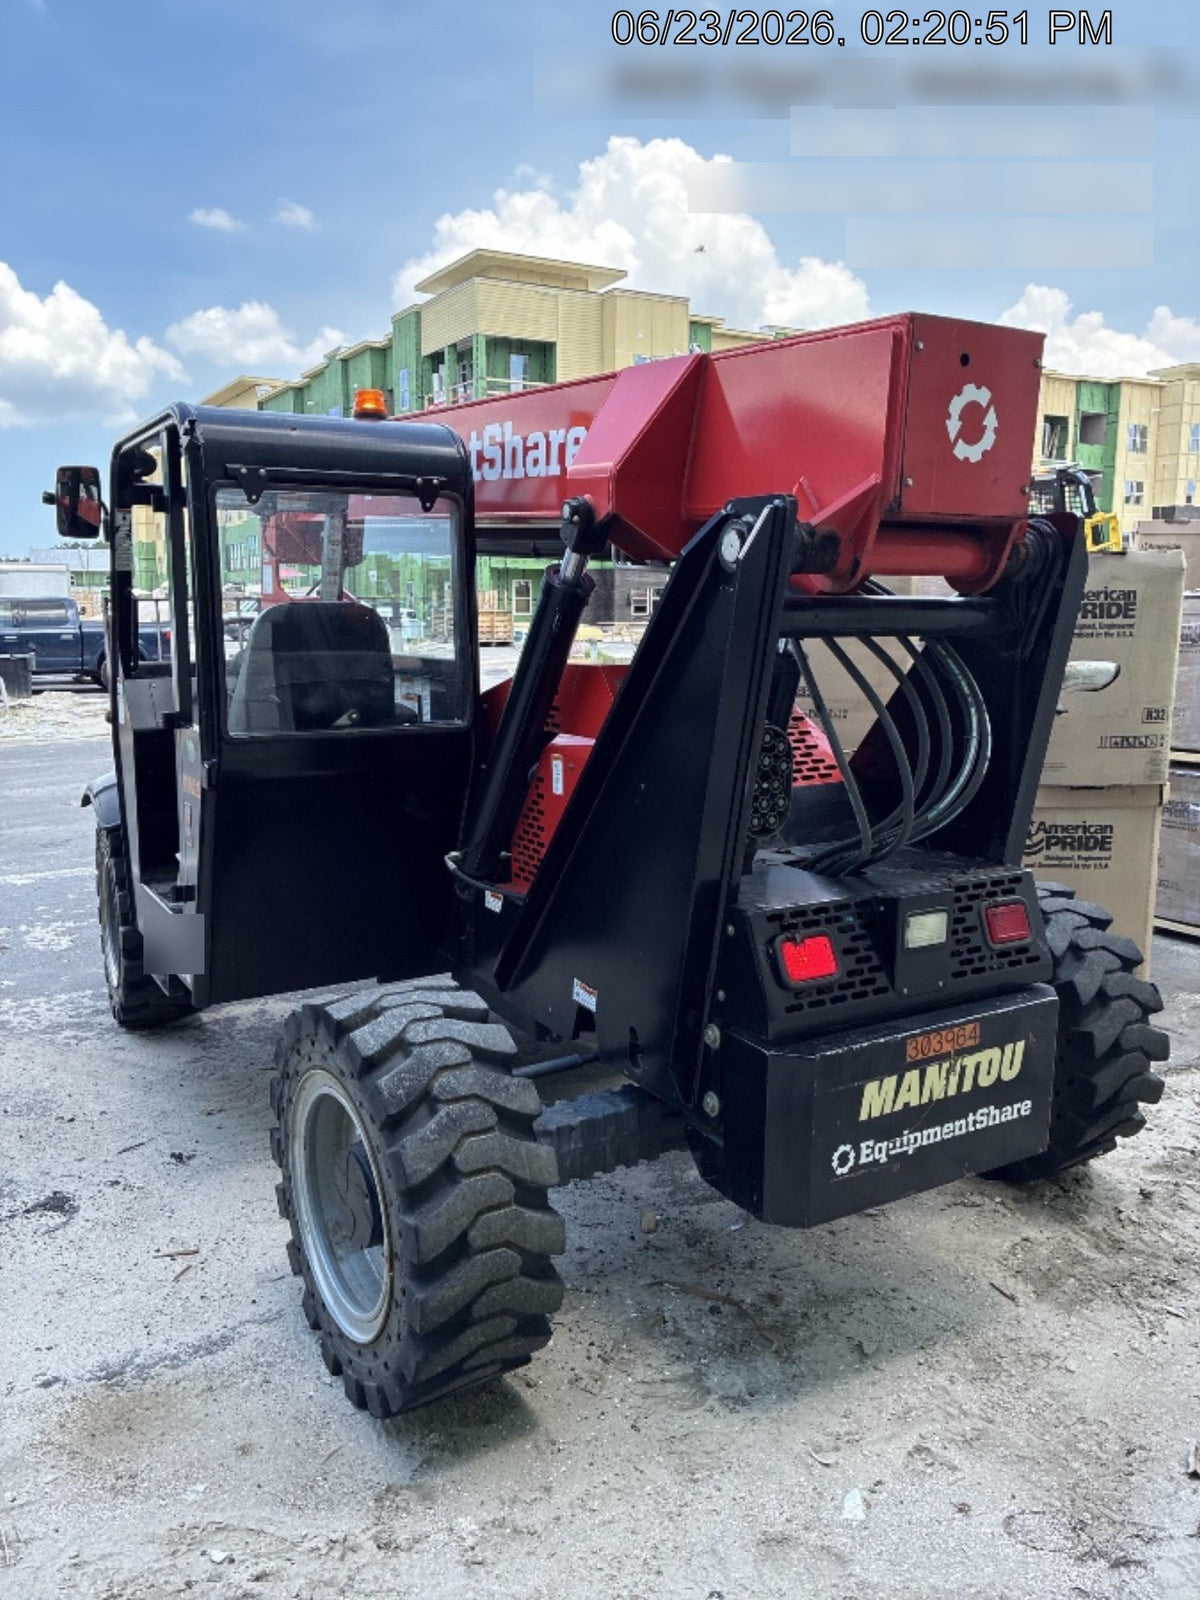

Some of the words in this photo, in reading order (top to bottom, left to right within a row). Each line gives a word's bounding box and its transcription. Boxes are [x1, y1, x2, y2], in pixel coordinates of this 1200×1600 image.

[469, 421, 587, 481] tShare
[1035, 820, 1114, 836] American
[1045, 835, 1113, 852] PRIDE
[907, 1024, 978, 1060] 303964
[859, 1040, 1025, 1122] MANITOU
[859, 1099, 1032, 1164] EquipmentShare
